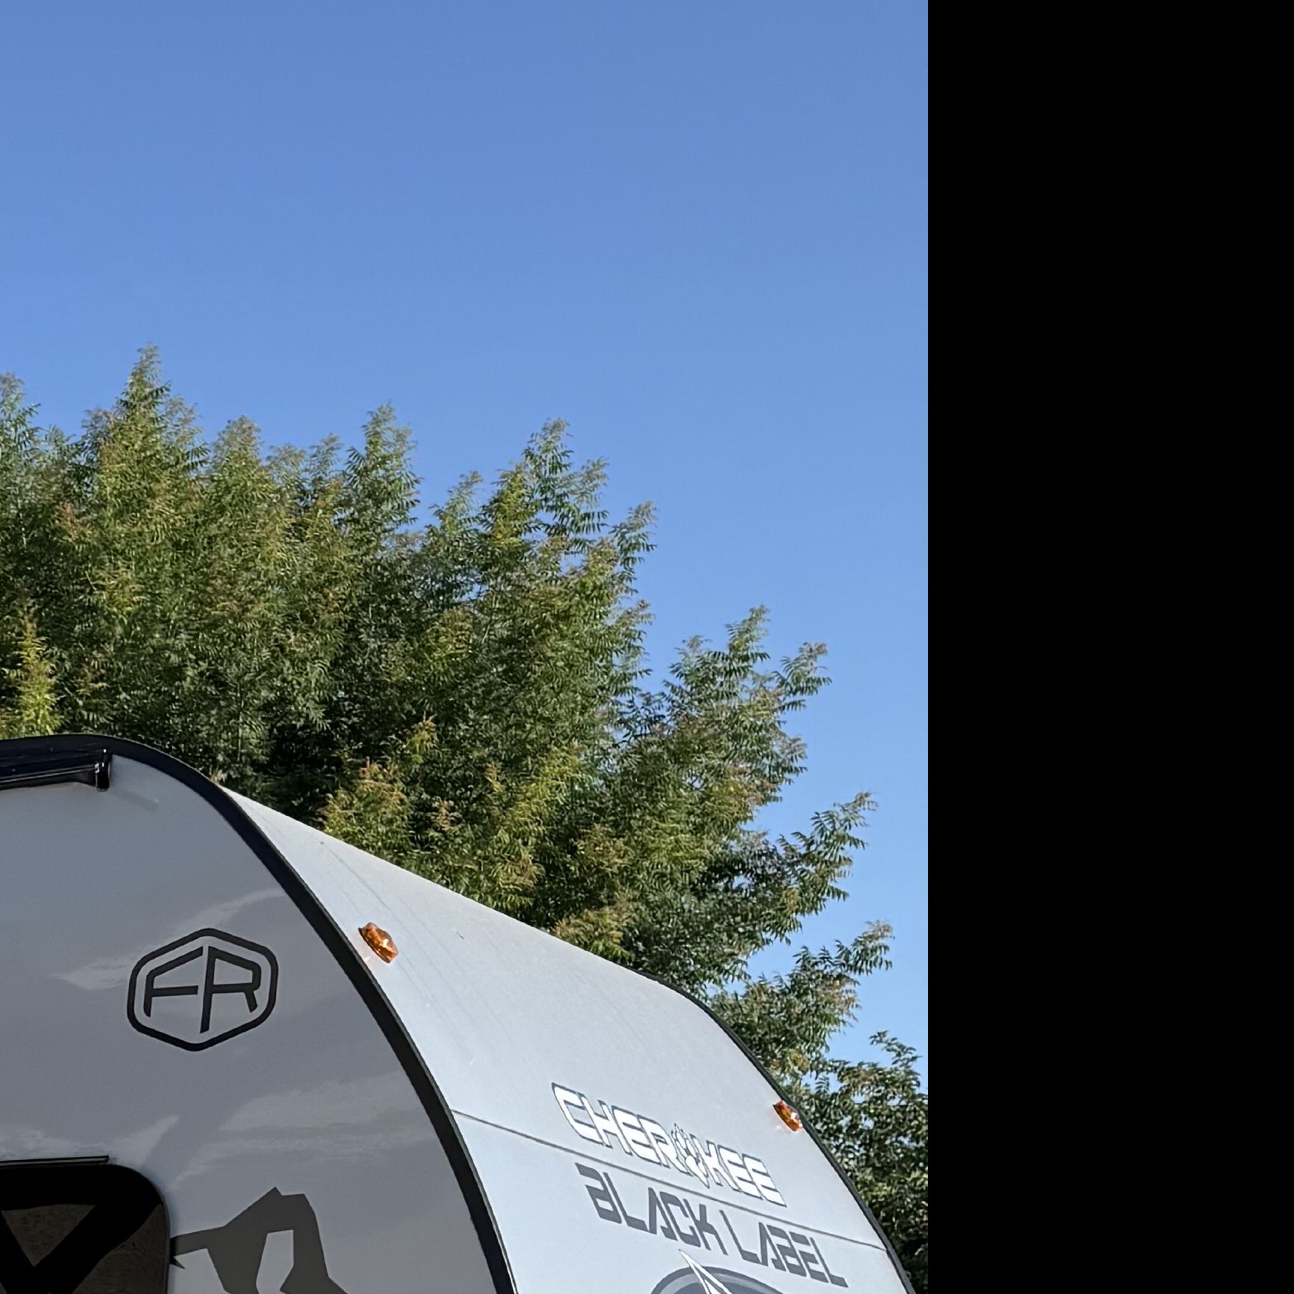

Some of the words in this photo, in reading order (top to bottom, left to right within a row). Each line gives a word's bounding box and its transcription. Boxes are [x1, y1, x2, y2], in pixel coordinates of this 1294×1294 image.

[551, 1082, 787, 1208] CHEROKEE
[575, 1162, 729, 1256] BLACK
[720, 1210, 849, 1289] LABEL
